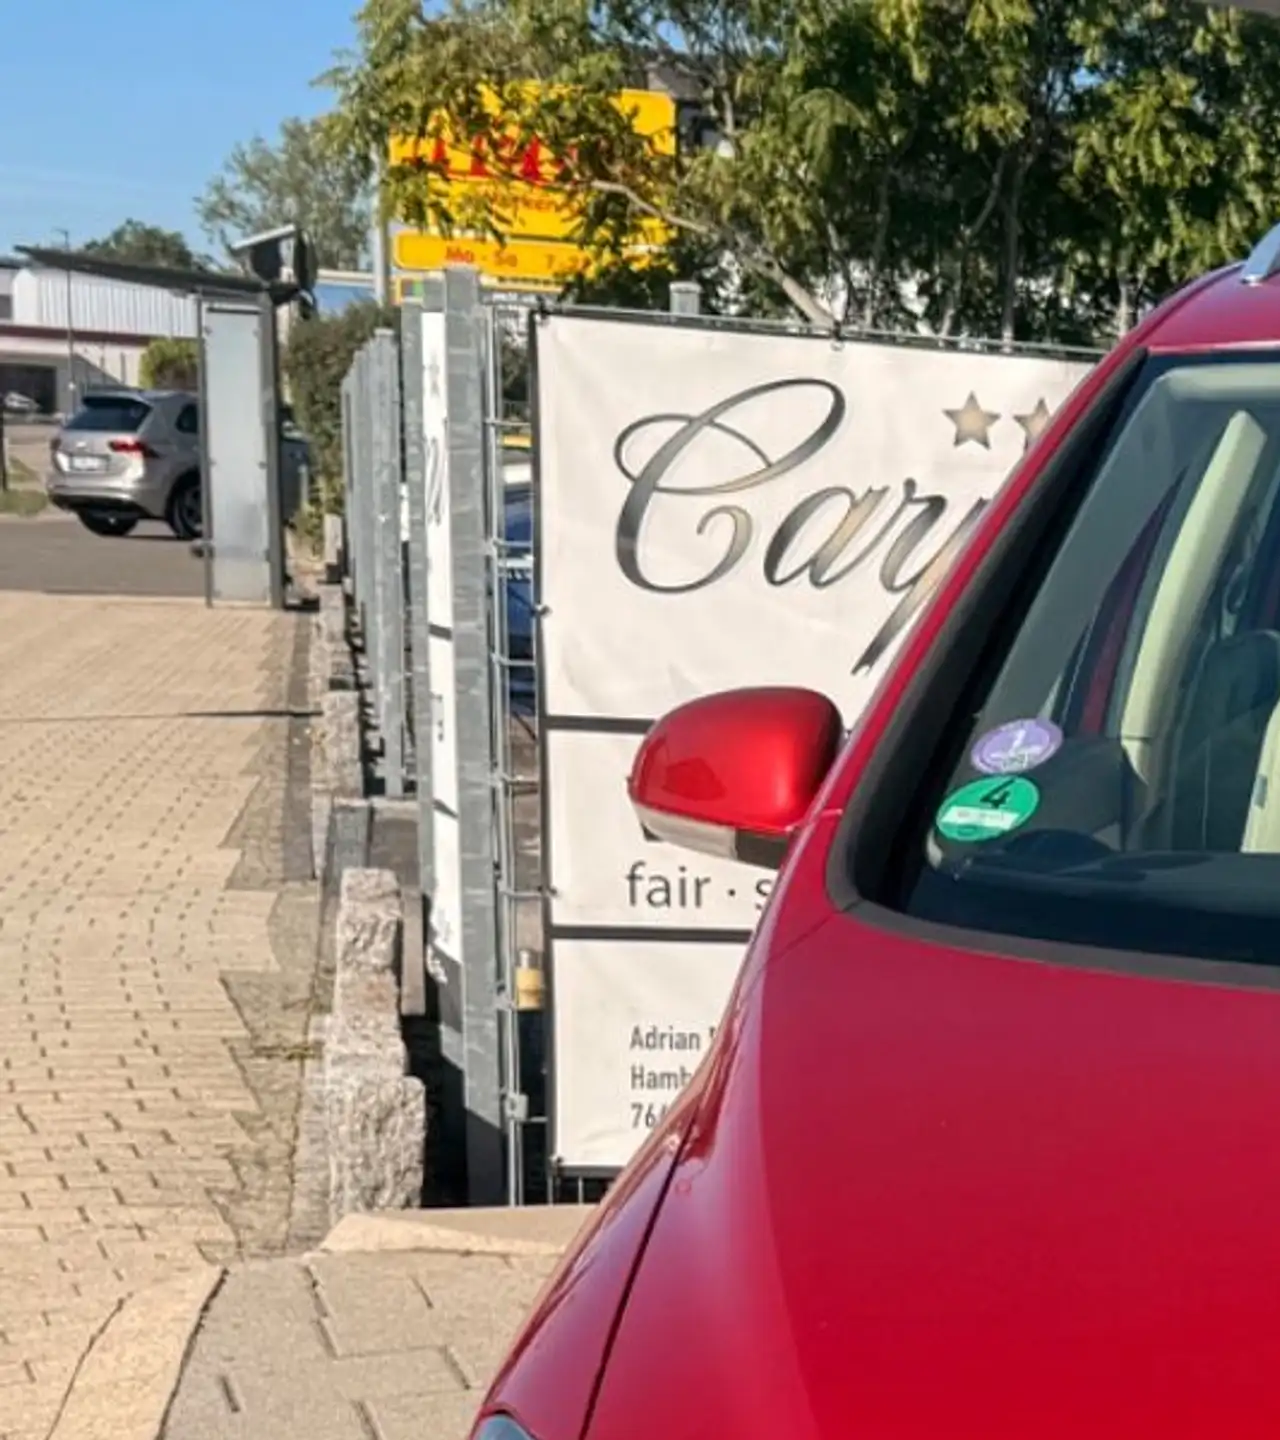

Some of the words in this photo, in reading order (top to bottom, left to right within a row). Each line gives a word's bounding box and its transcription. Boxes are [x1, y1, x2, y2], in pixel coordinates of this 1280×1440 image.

[979, 779, 1017, 810] 4
[625, 860, 711, 908] fair
[630, 1025, 700, 1051] Adrian
[631, 1102, 667, 1129] 76
